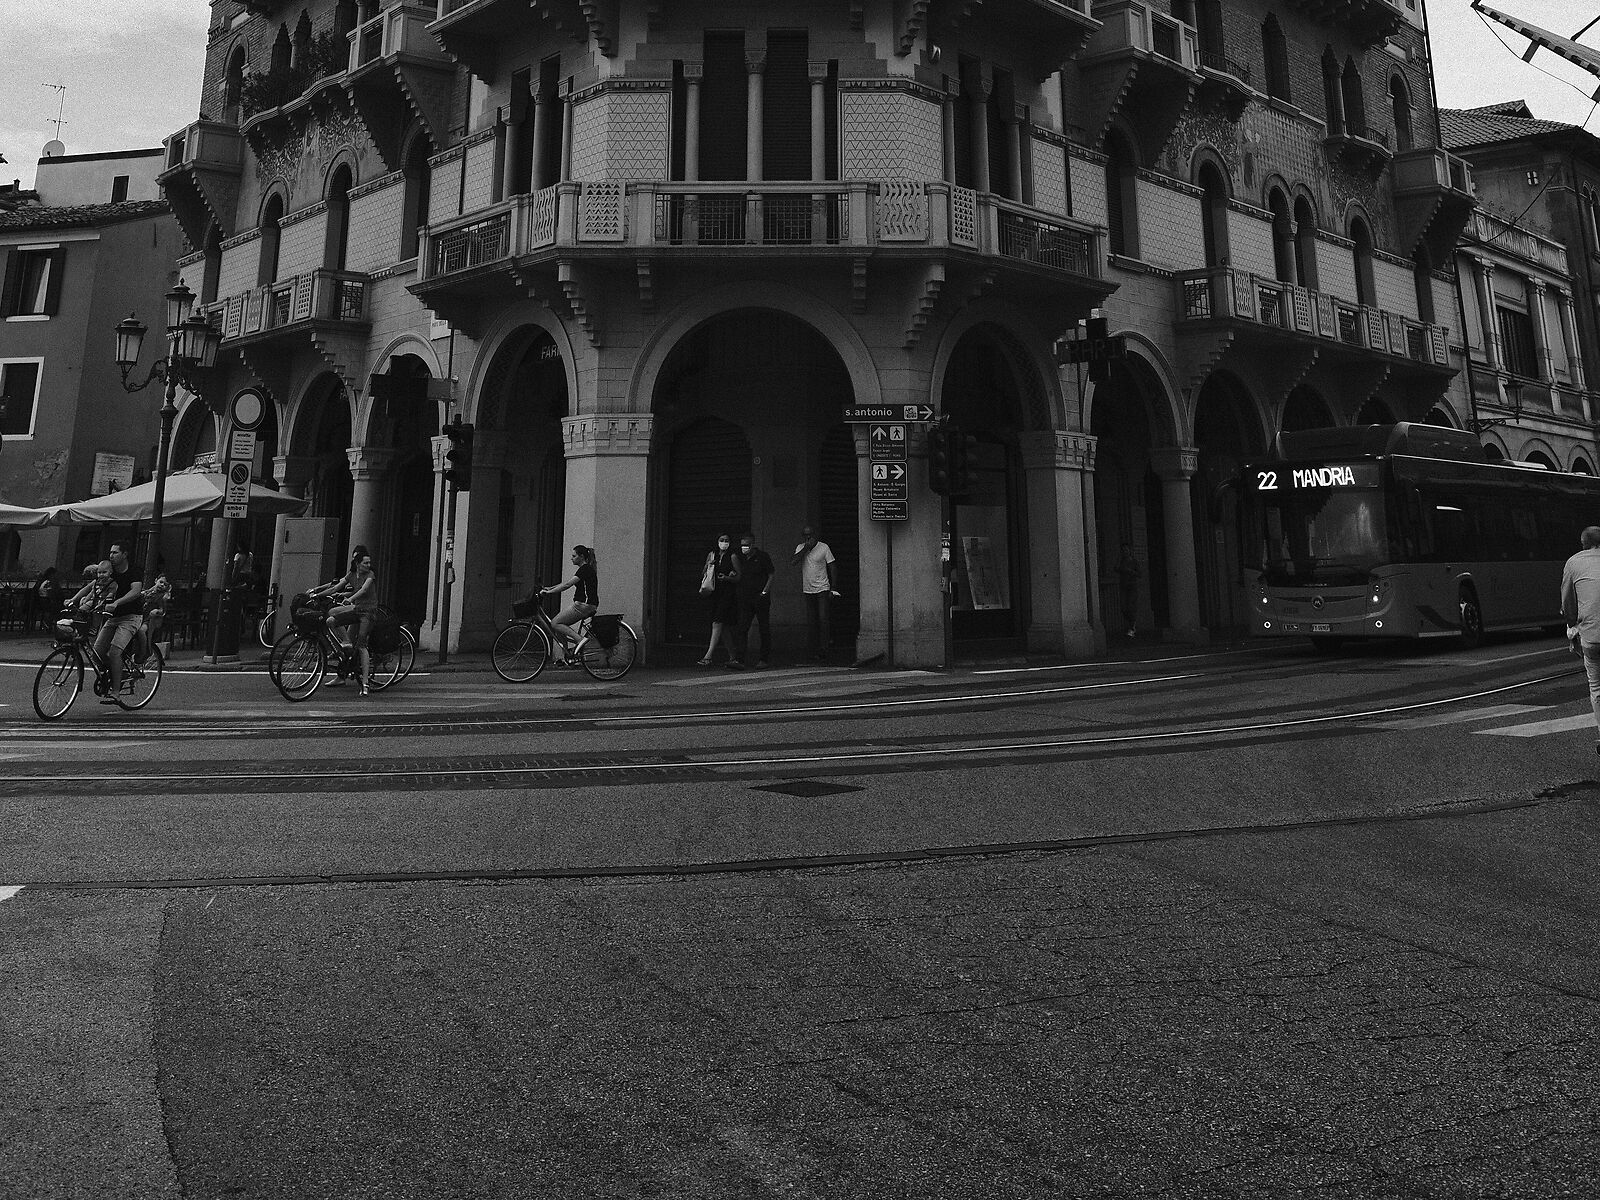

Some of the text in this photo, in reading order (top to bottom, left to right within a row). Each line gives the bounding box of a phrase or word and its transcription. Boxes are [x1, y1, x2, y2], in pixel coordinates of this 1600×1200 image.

[845, 407, 893, 417] s.antonio
[1257, 466, 1356, 490] 22 MANDRIA
